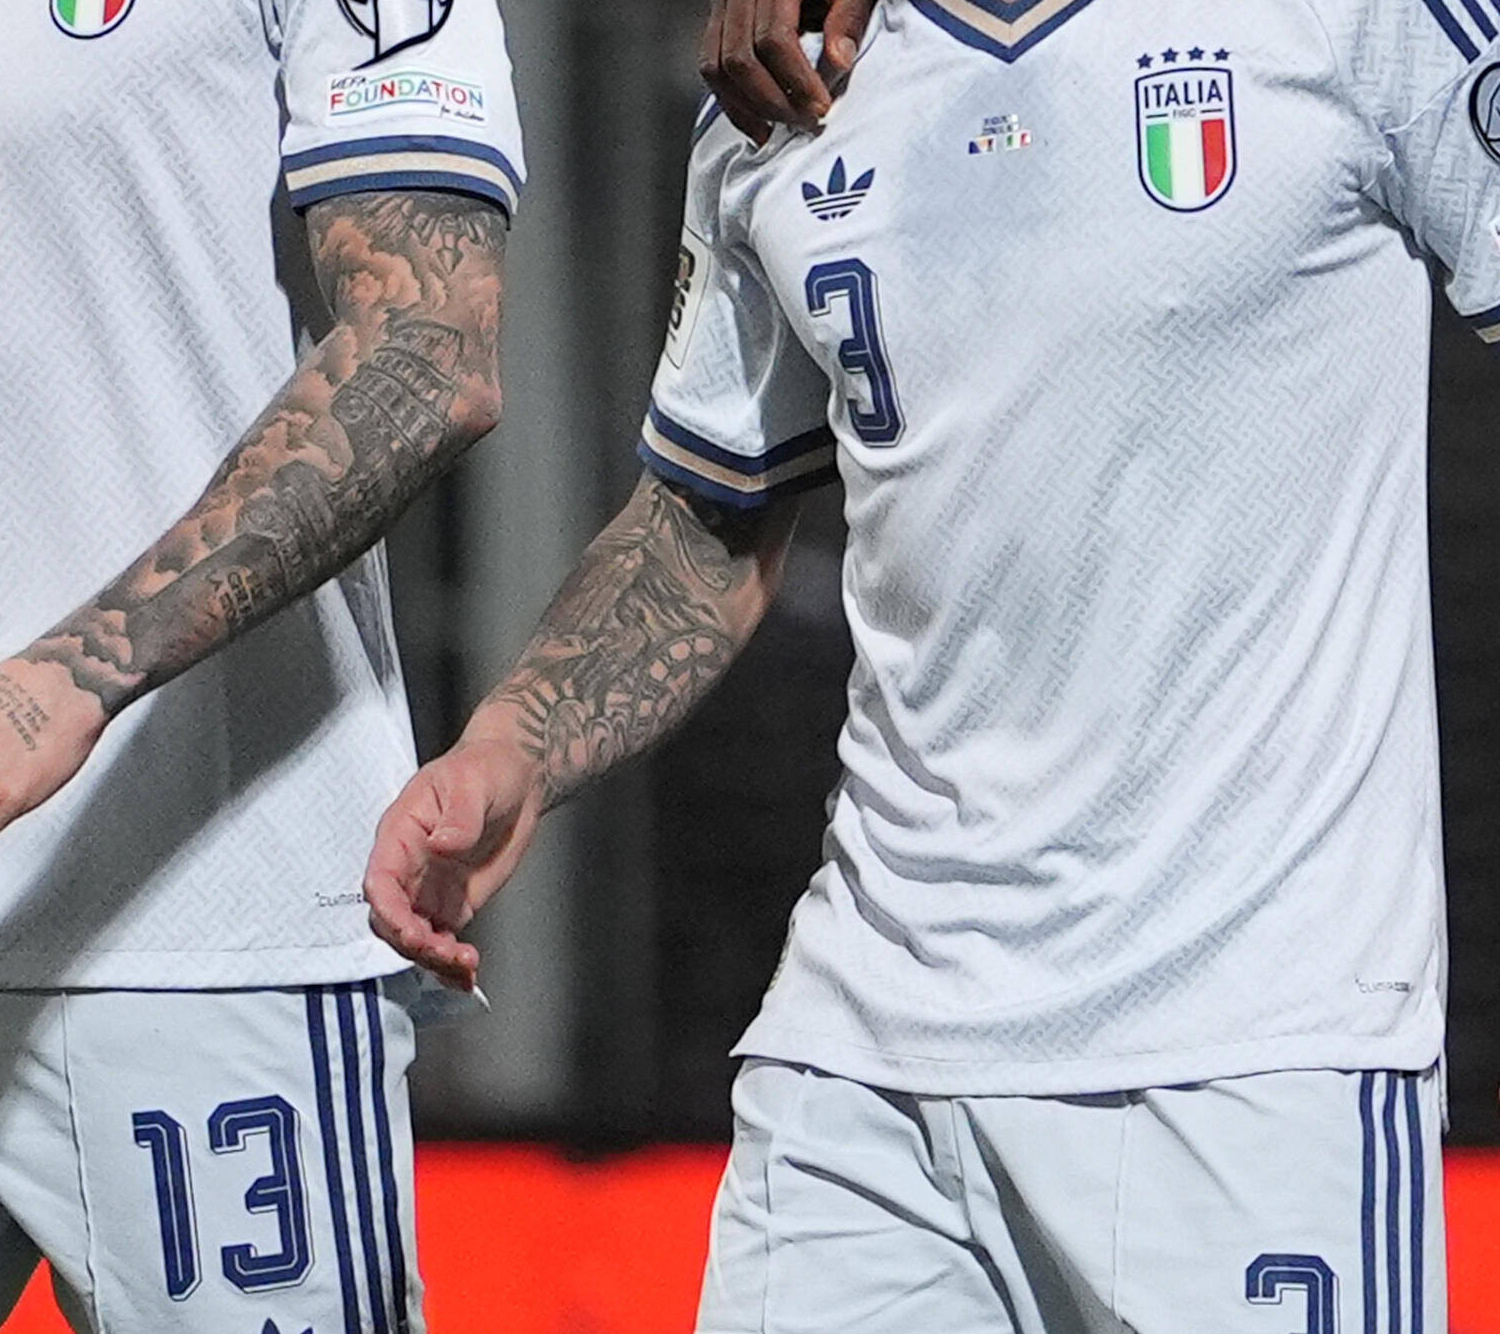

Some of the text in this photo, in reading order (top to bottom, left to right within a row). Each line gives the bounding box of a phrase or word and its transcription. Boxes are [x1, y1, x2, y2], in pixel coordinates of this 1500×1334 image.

[330, 78, 485, 110] FOUNDATION
[1143, 78, 1224, 110] ITALIA
[803, 256, 907, 448] 3
[131, 1094, 315, 1302] 13
